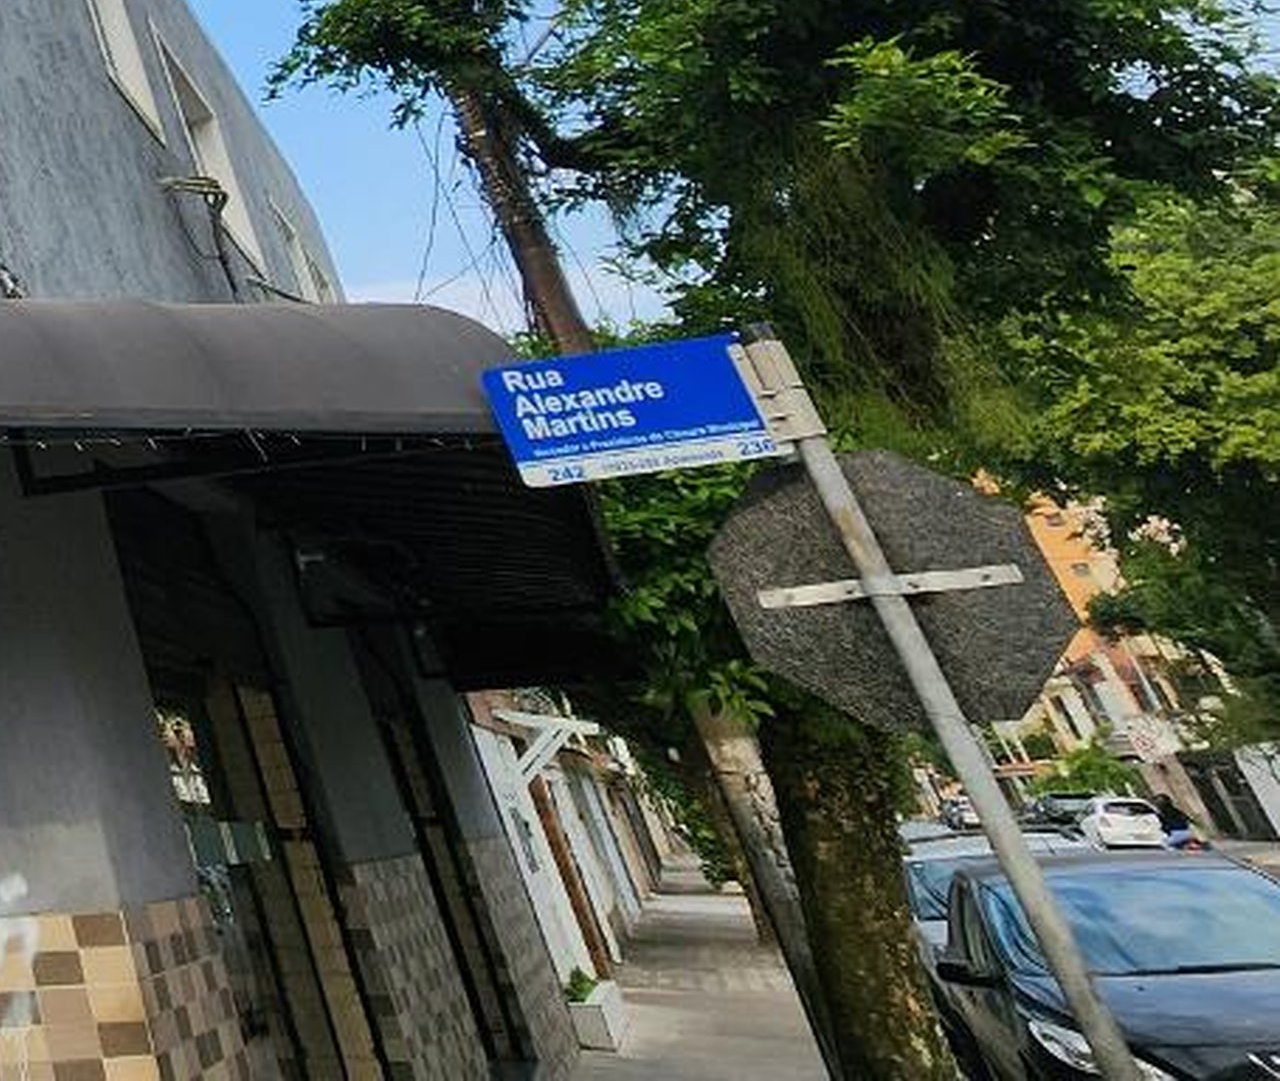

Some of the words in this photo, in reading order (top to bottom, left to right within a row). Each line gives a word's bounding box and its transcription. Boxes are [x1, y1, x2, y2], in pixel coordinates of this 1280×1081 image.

[502, 370, 564, 393] Rua
[516, 379, 664, 418] Alexandre
[522, 408, 637, 440] Martins
[548, 465, 585, 482] 242
